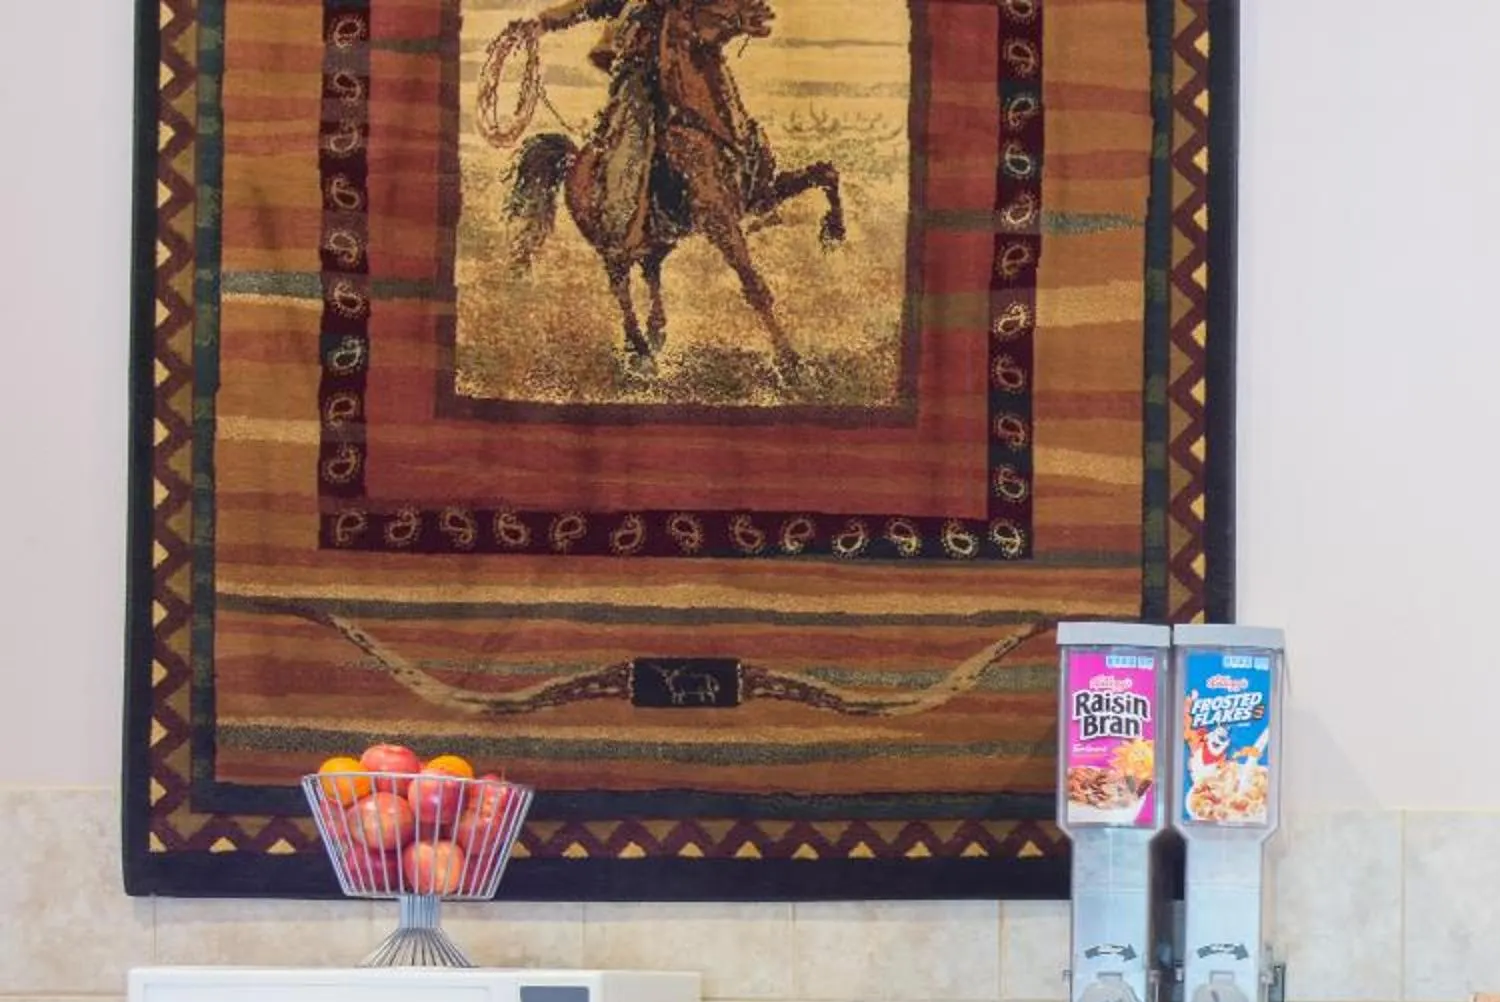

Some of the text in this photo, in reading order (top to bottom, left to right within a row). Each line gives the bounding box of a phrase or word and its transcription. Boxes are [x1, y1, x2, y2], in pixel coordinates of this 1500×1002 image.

[1074, 691, 1149, 718] Raisin
[1191, 692, 1262, 716] FROSTED
[1082, 713, 1142, 737] Bran
[1193, 706, 1252, 728] FLAKES
